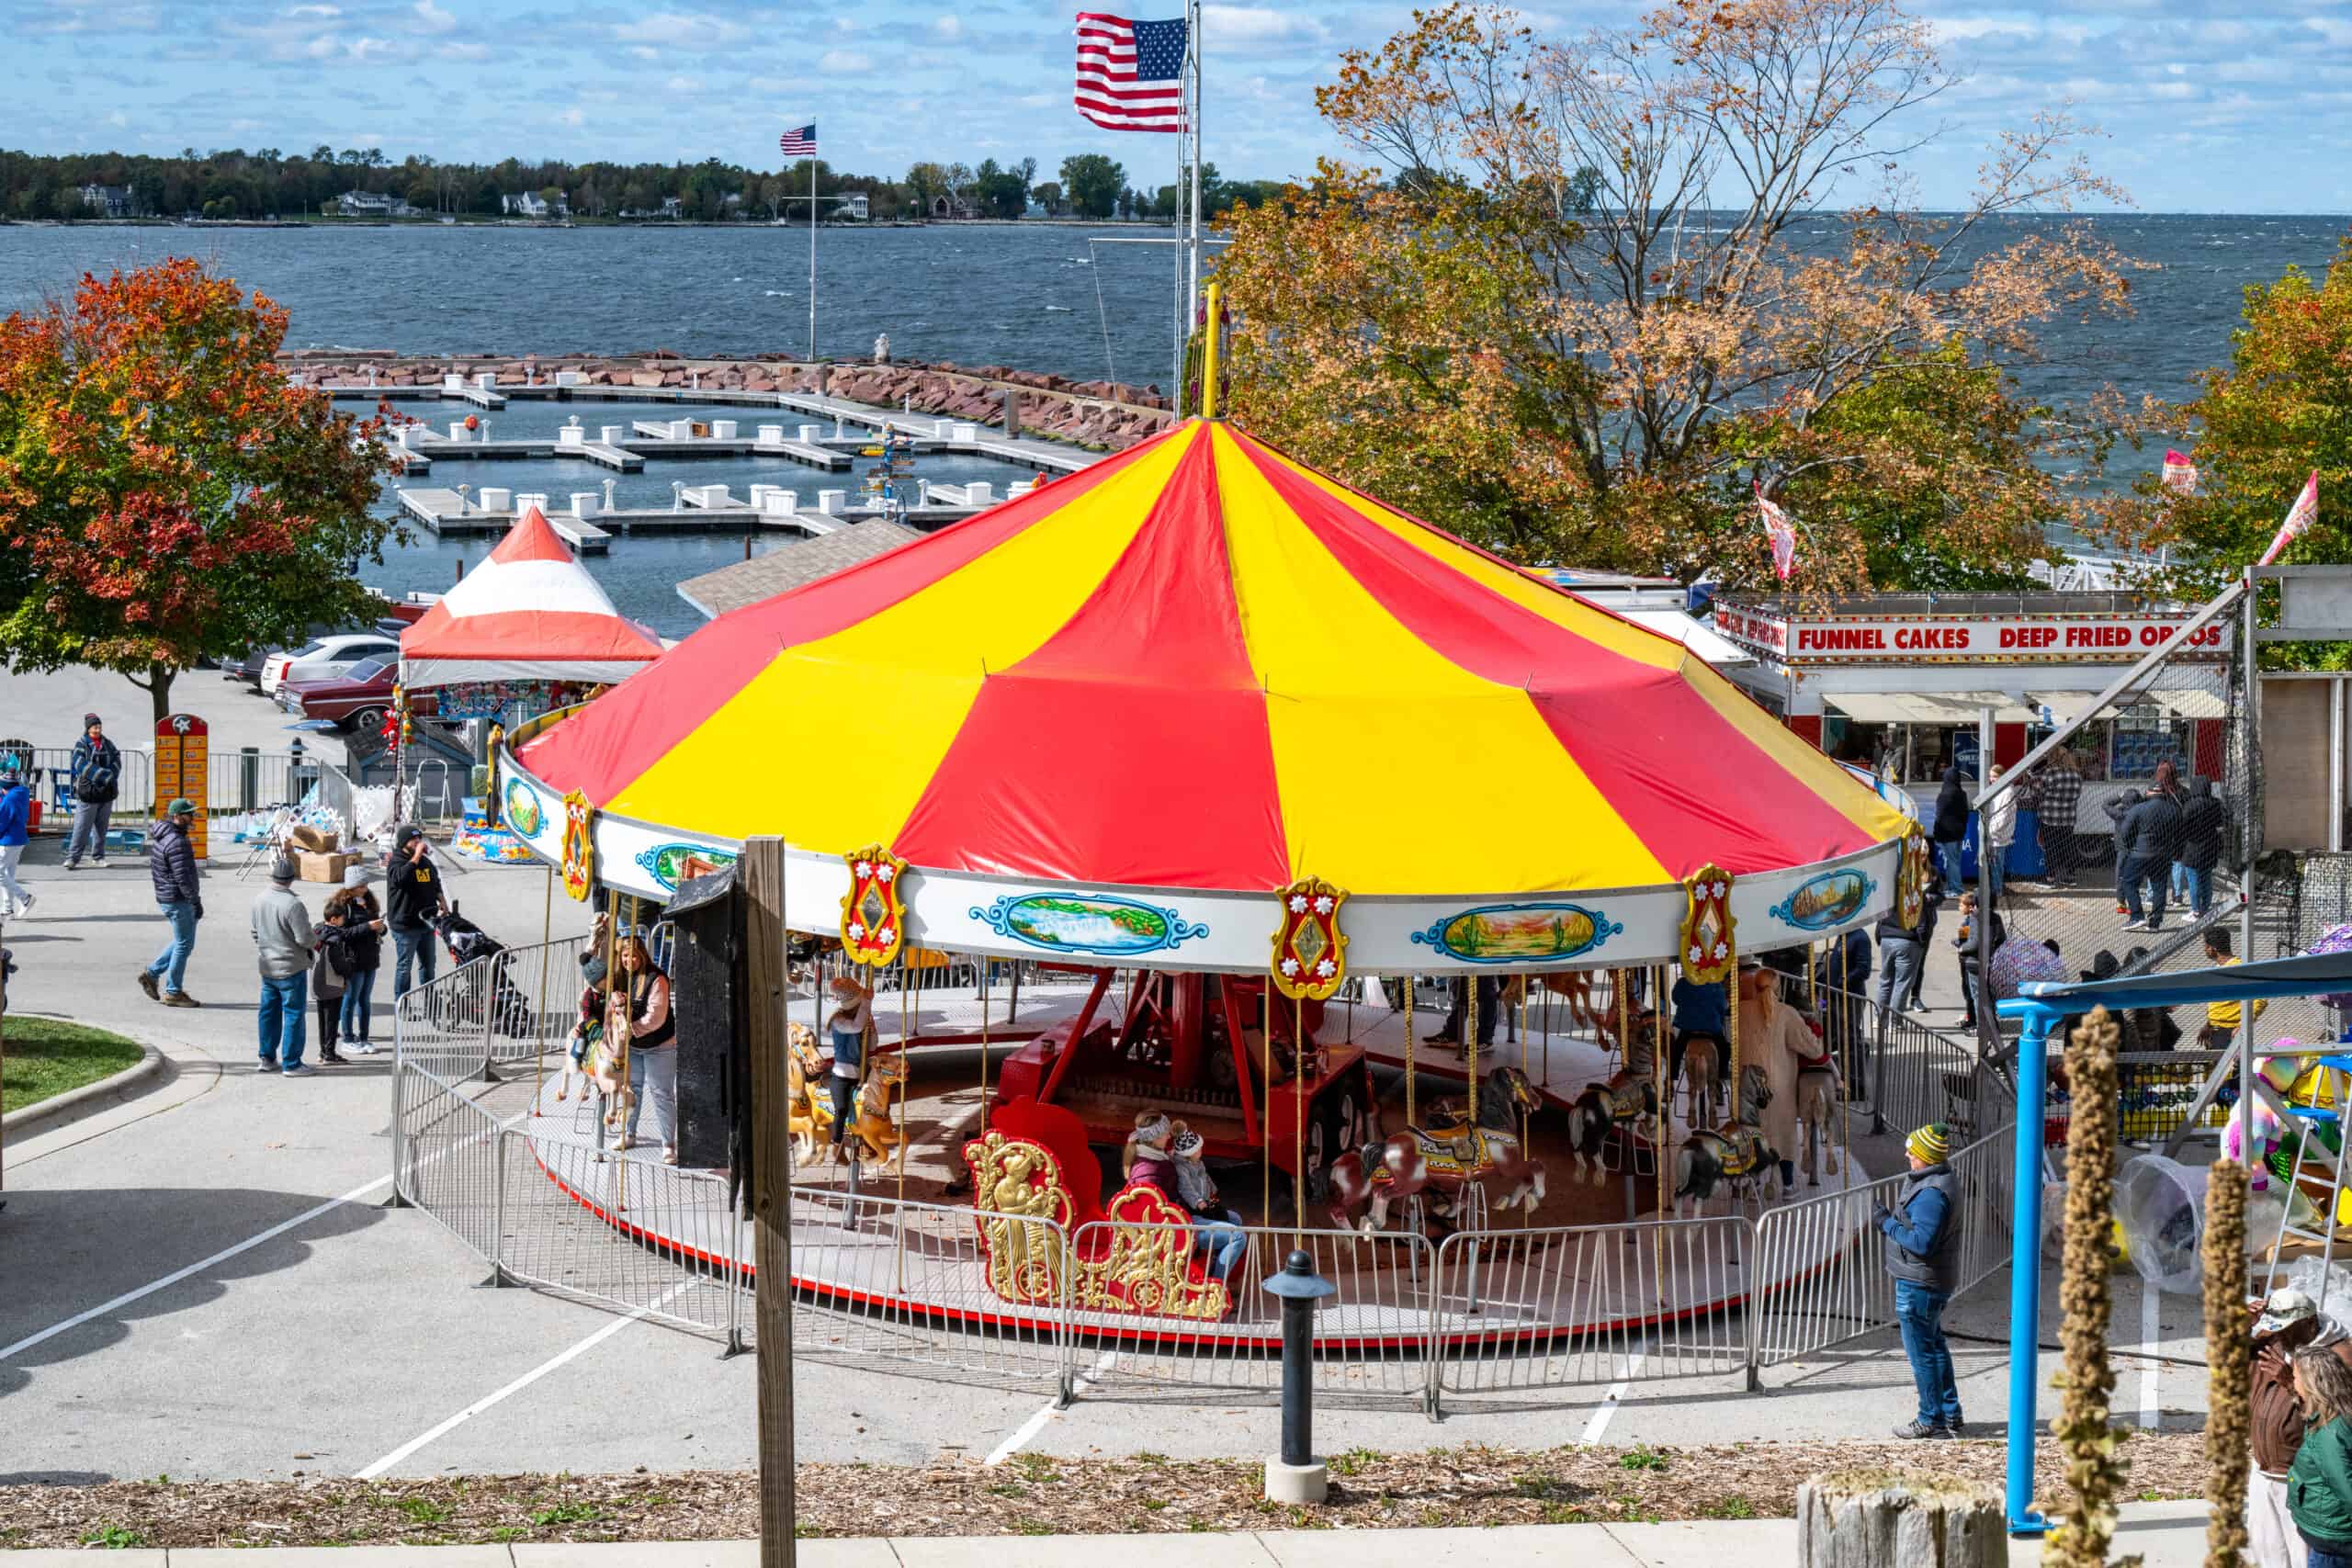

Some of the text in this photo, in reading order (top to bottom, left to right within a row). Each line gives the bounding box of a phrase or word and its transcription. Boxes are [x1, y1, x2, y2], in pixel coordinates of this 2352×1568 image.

[1798, 628, 1970, 649] FUNNEL CAKES
[1999, 626, 2221, 648] DEEP FRIED OROS
